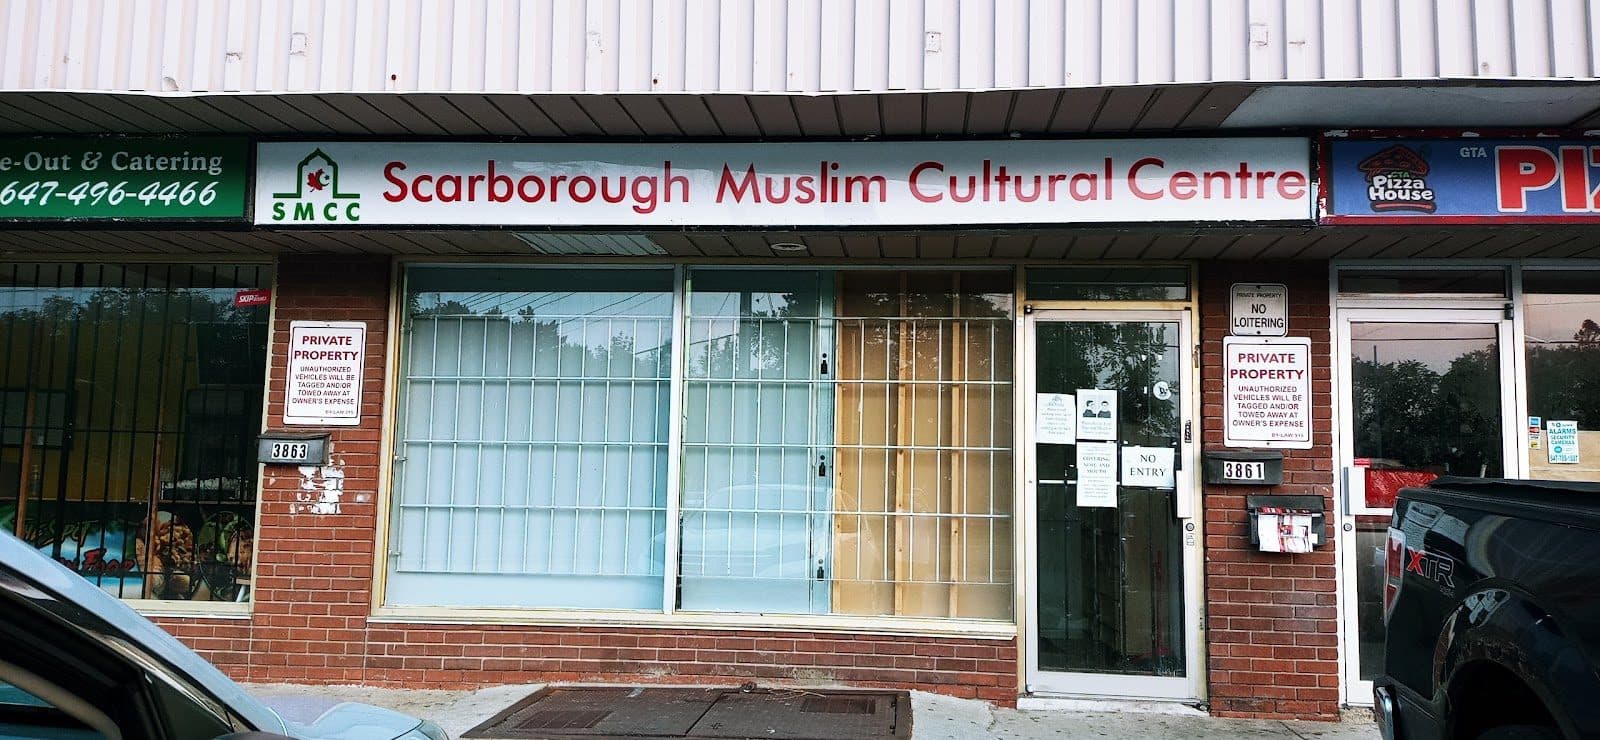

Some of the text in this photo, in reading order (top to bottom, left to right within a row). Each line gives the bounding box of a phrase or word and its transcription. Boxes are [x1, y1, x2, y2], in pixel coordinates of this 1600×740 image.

[1460, 147, 1488, 158] GTA
[0, 150, 223, 176] e-Out & Catering
[1373, 174, 1425, 190] Pizza
[1495, 145, 1600, 212] PI
[383, 157, 1307, 214] Scarborough Muslim Cultural Centre
[0, 181, 220, 206] 647-496-4466
[1368, 186, 1433, 201] House
[272, 201, 361, 221] SMCC
[1251, 303, 1267, 314] NO
[1234, 317, 1284, 328] LOITERING
[302, 335, 353, 346] PRIVATE
[294, 350, 359, 361] PROPERTY
[1238, 353, 1296, 363] PRIVATE
[295, 373, 328, 381] VEHICLES
[1230, 369, 1304, 380] PROPERTY
[1238, 385, 1298, 393] UNAUTHORIZED
[1237, 402, 1268, 410] TAGGED
[1232, 419, 1304, 428] OWNER'S EXPENSE
[273, 443, 307, 459] 3863
[1140, 454, 1156, 463] NO
[1130, 467, 1167, 477] ENTRY
[1226, 463, 1262, 479] 3861
[1406, 545, 1456, 588] XTR
